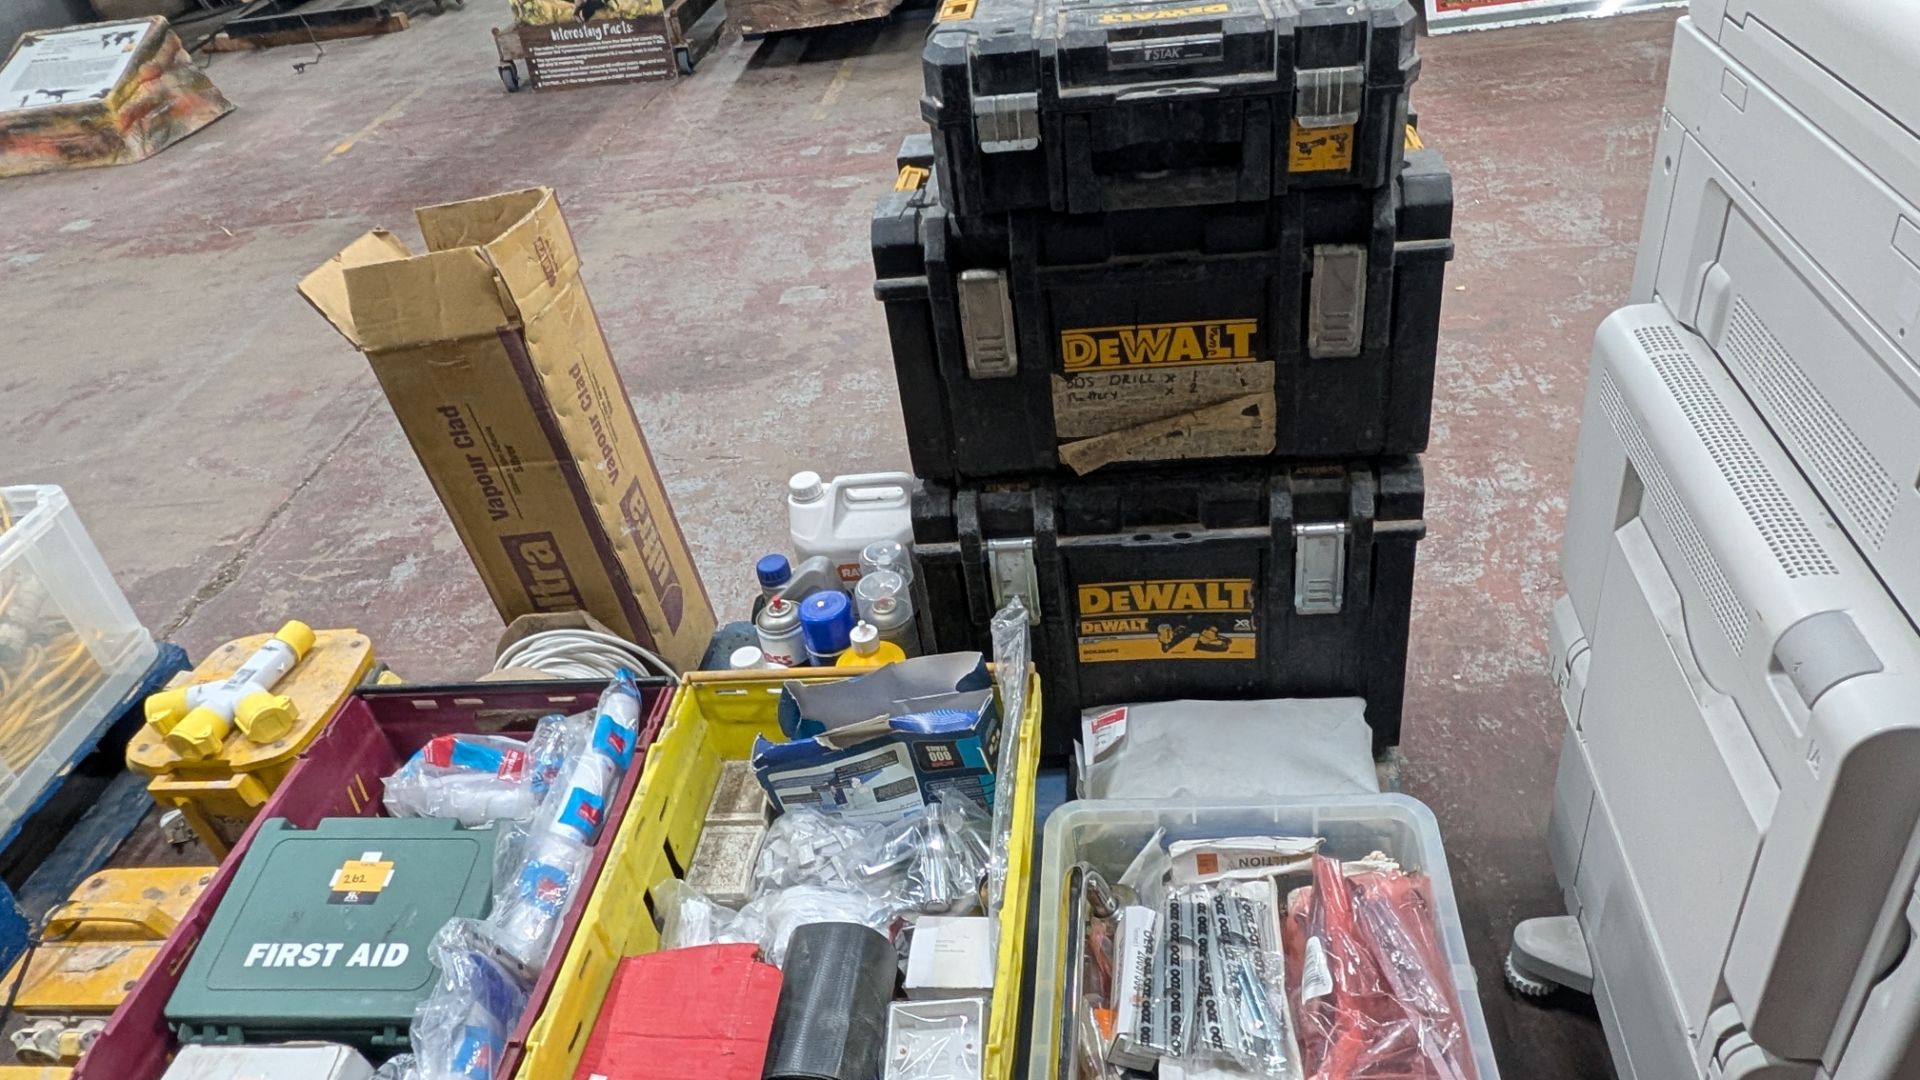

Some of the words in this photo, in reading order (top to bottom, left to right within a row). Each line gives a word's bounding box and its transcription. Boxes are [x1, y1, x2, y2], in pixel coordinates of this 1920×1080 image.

[551, 25, 602, 41] Interesting
[568, 363, 592, 411] Clad
[1109, 374, 1155, 385] DRILL
[1190, 383, 1198, 393] 2
[437, 405, 474, 449] Clad
[588, 414, 619, 486] Vapour
[465, 454, 509, 521] Vapour
[629, 485, 671, 586] ultra
[1078, 583, 1251, 613] DEWALT
[1170, 903, 1179, 920] ZOO
[1171, 923, 1180, 943] ZOO
[1198, 916, 1207, 934] ZOO
[244, 943, 344, 967] FIRST
[346, 943, 409, 967] AID
[1171, 945, 1180, 966] ZOO
[1198, 938, 1208, 957] ZOO
[1171, 969, 1180, 989] ZOO
[1171, 993, 1180, 1013] ZOO
[1206, 1000, 1217, 1022] ZOO
[1171, 1016, 1180, 1035] ZOO
